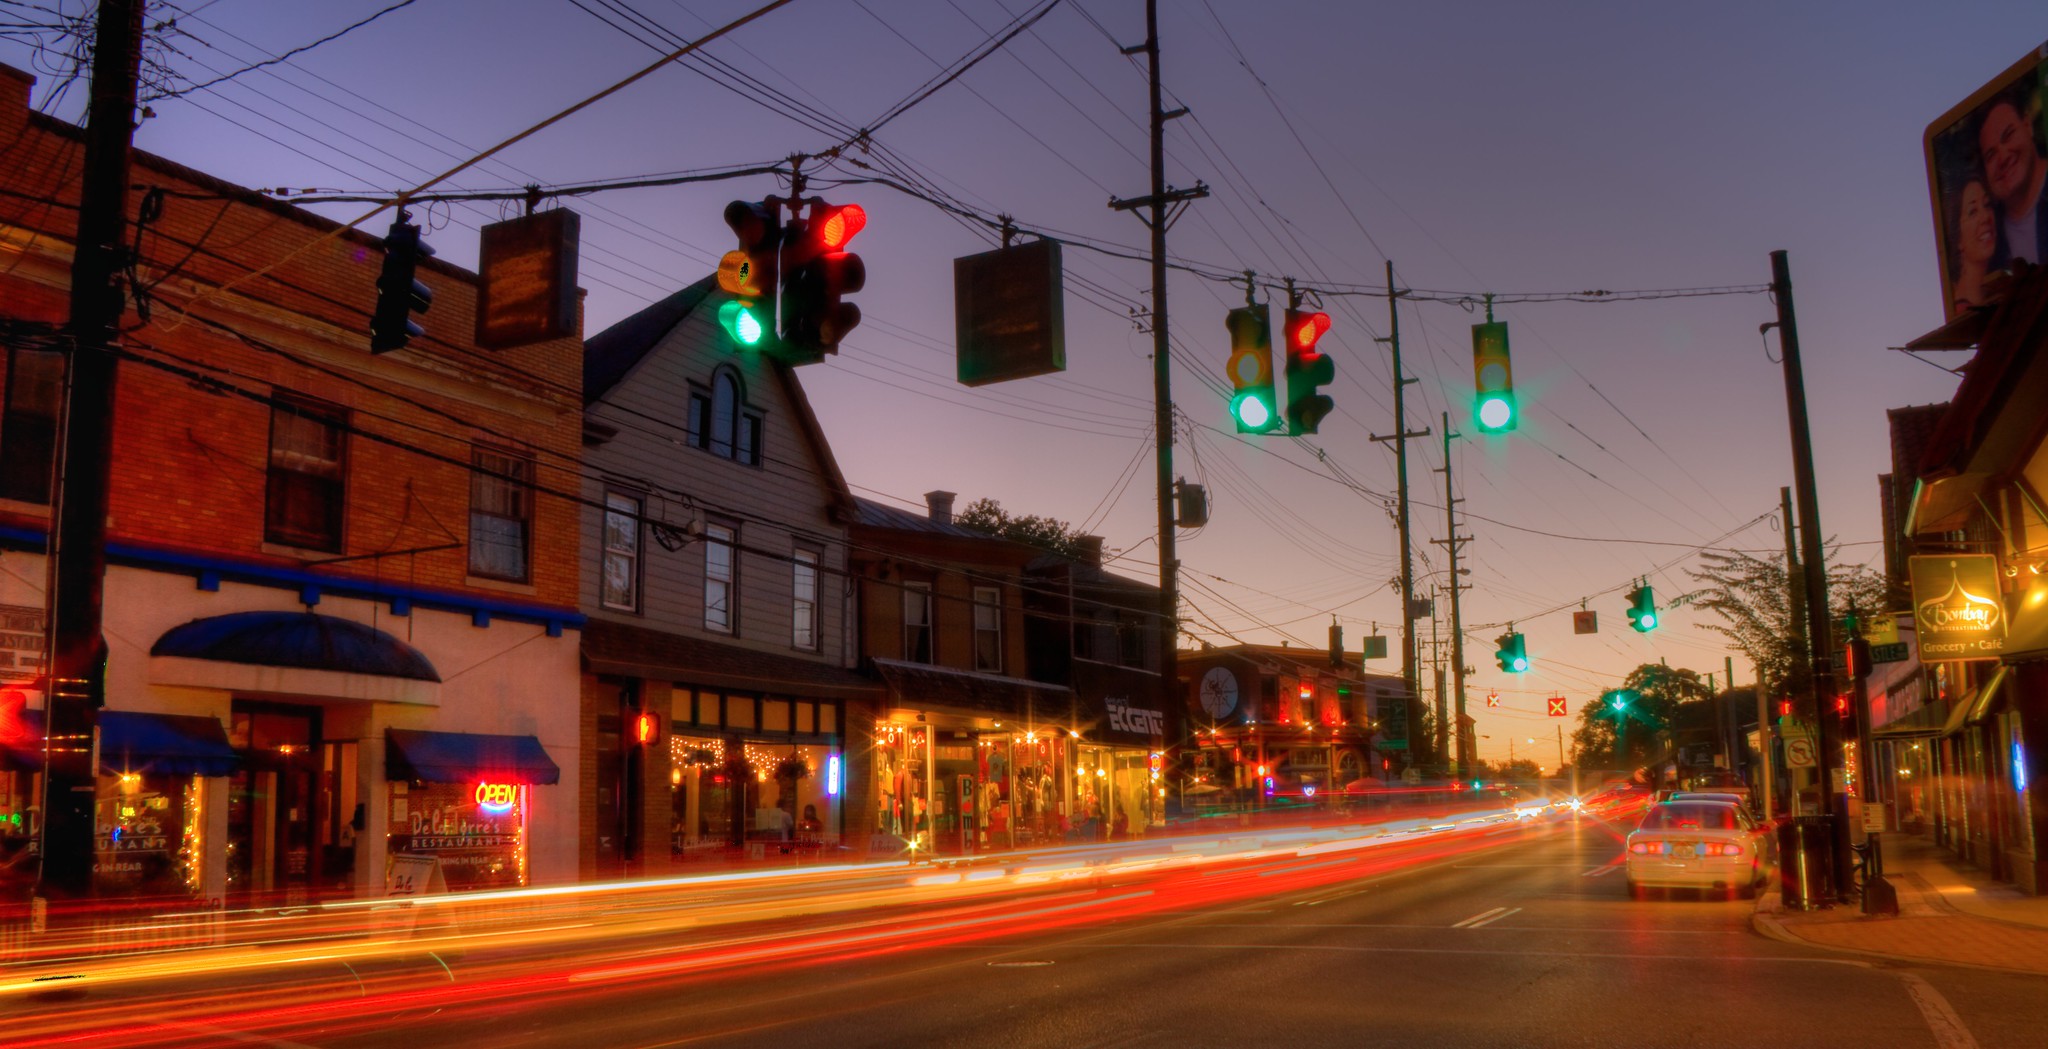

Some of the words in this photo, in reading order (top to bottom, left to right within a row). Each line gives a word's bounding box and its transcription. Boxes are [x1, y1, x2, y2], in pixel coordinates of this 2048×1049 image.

[1928, 601, 1989, 626] Bombay
[1923, 643, 1966, 654] Grocery
[1979, 639, 2003, 650] Café
[475, 784, 517, 805] OPEN
[412, 837, 501, 848] RESTAURANT
[101, 864, 117, 872] IN
[117, 862, 142, 872] REAR
